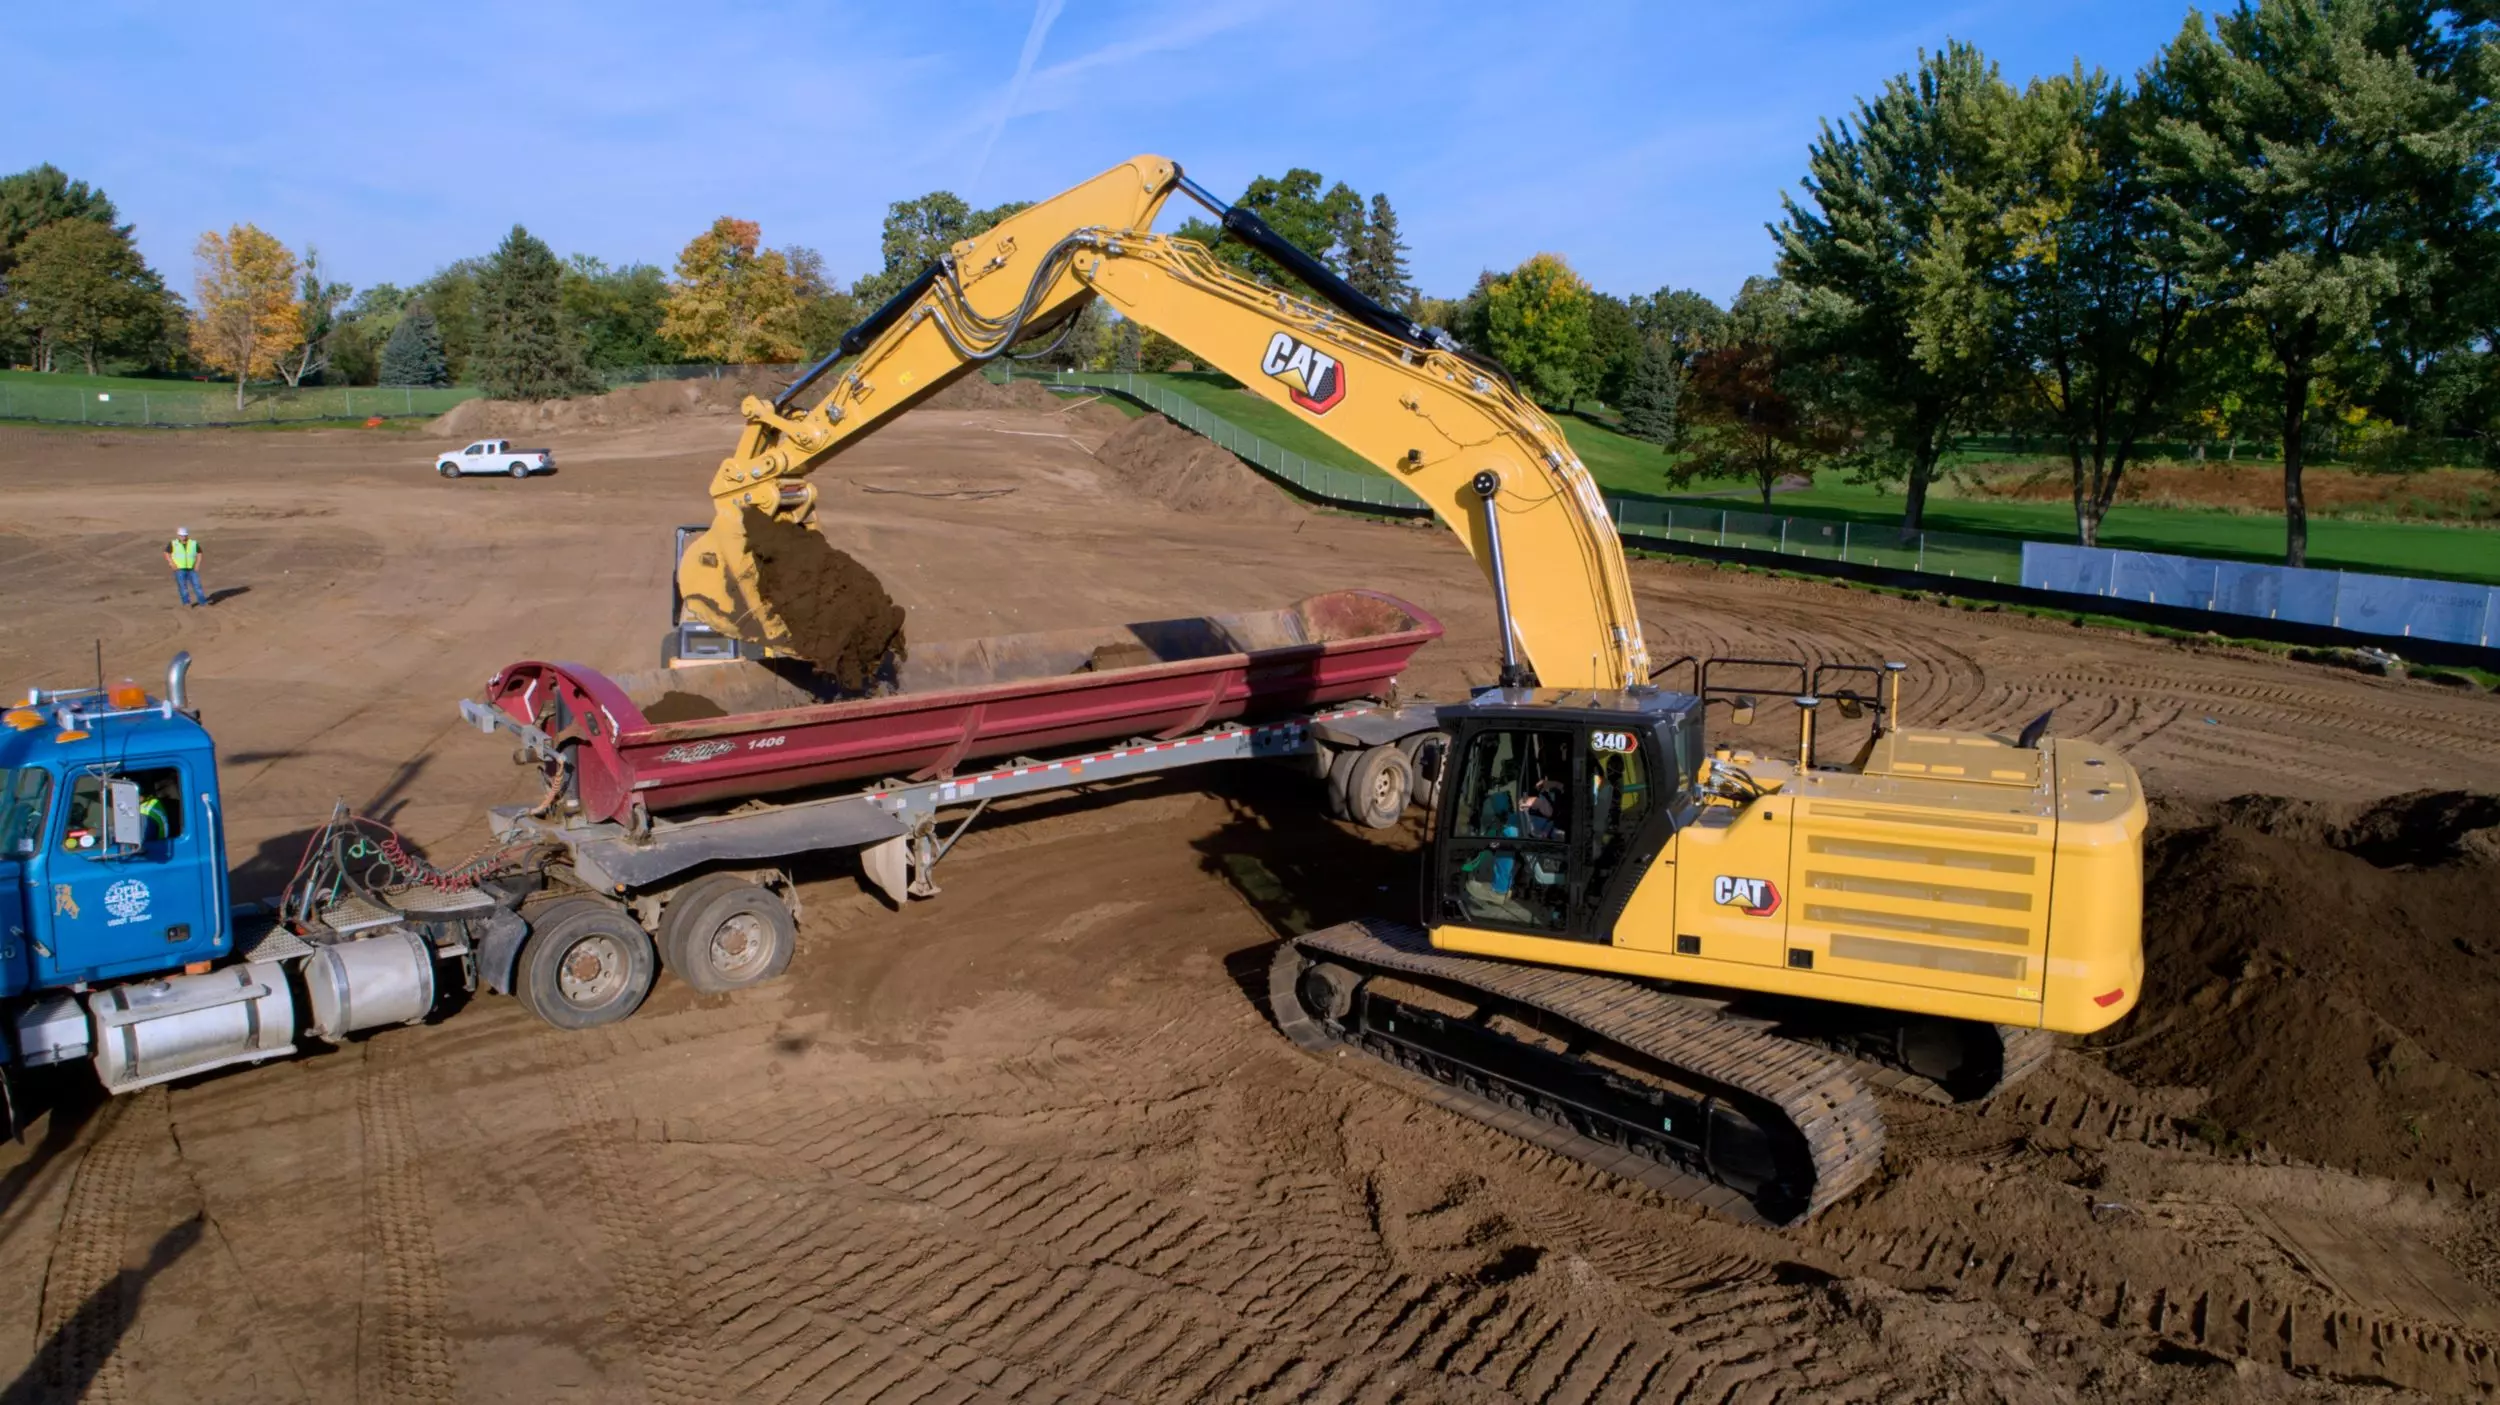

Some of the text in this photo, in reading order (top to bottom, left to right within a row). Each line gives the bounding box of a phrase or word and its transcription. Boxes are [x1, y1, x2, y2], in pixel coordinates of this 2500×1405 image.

[1262, 332, 1336, 397] CAT
[748, 736, 786, 750] 1406
[1592, 731, 1627, 751] 340
[1715, 876, 1766, 908] CAT
